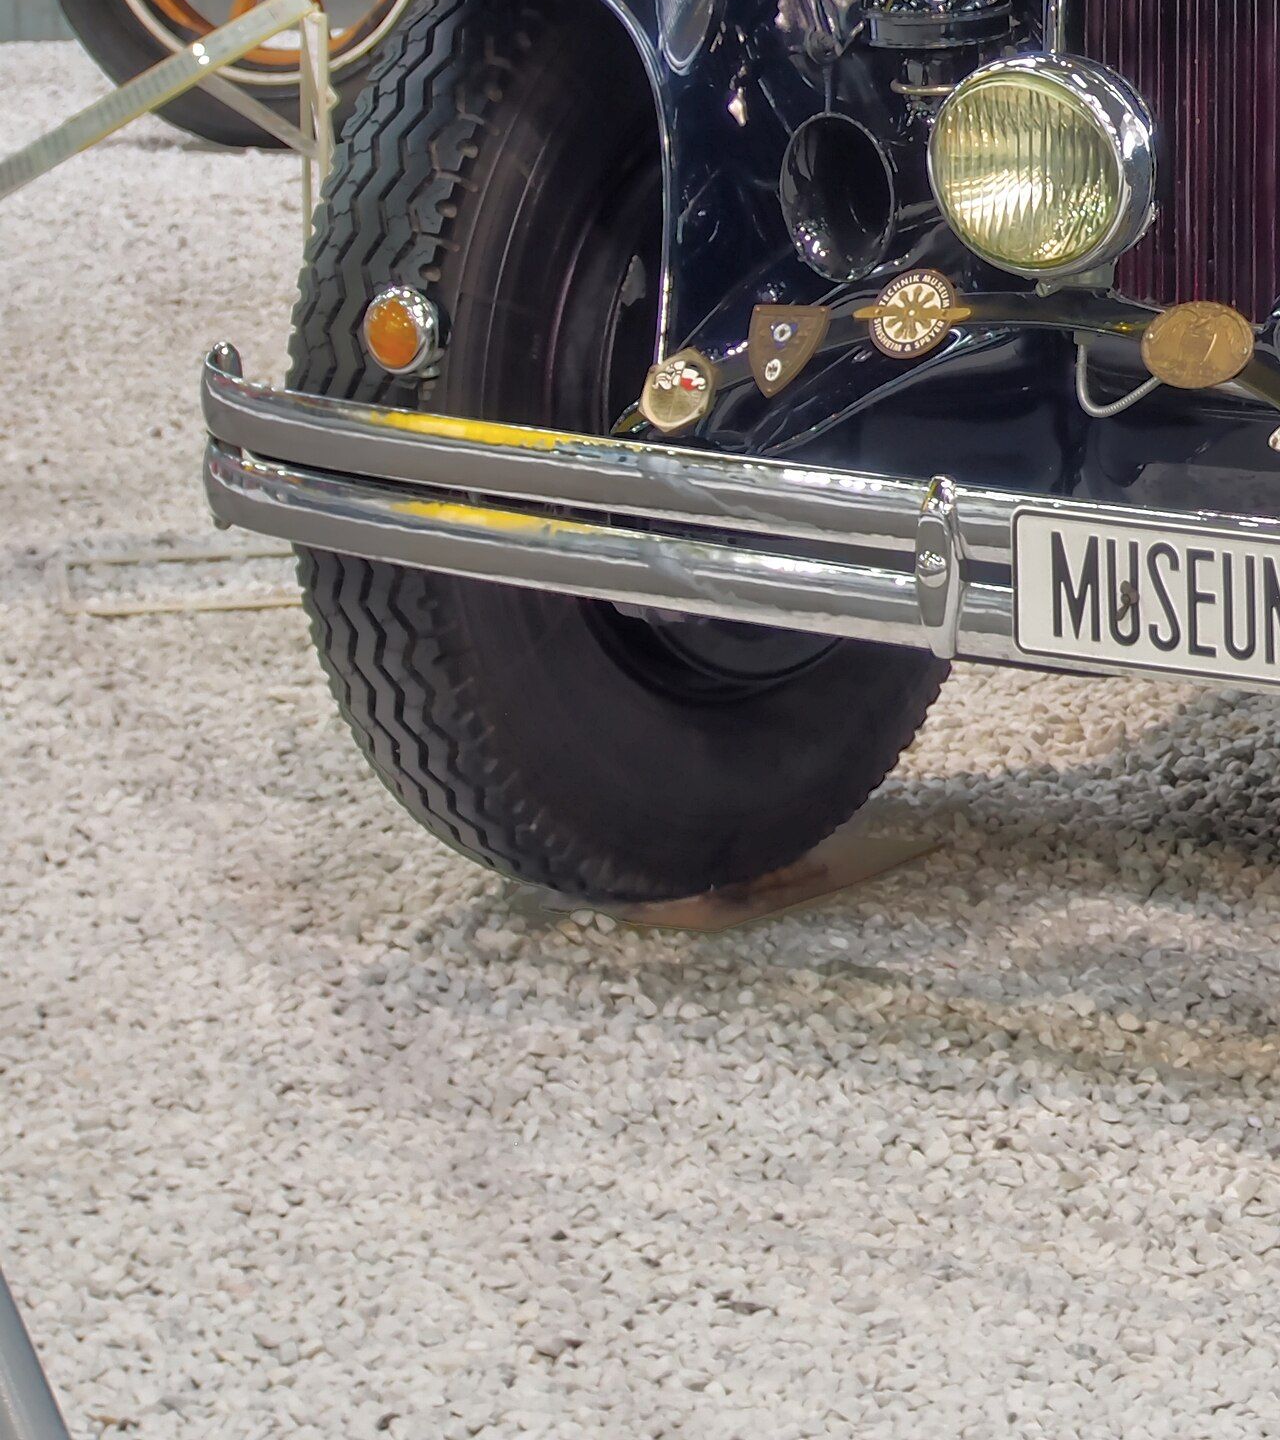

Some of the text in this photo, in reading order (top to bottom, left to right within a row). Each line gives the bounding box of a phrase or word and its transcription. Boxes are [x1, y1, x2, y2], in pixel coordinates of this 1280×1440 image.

[879, 274, 950, 308] TECHNIK MUSEUM
[873, 318, 901, 352] SINSHEIM
[914, 320, 944, 349] SPEYER
